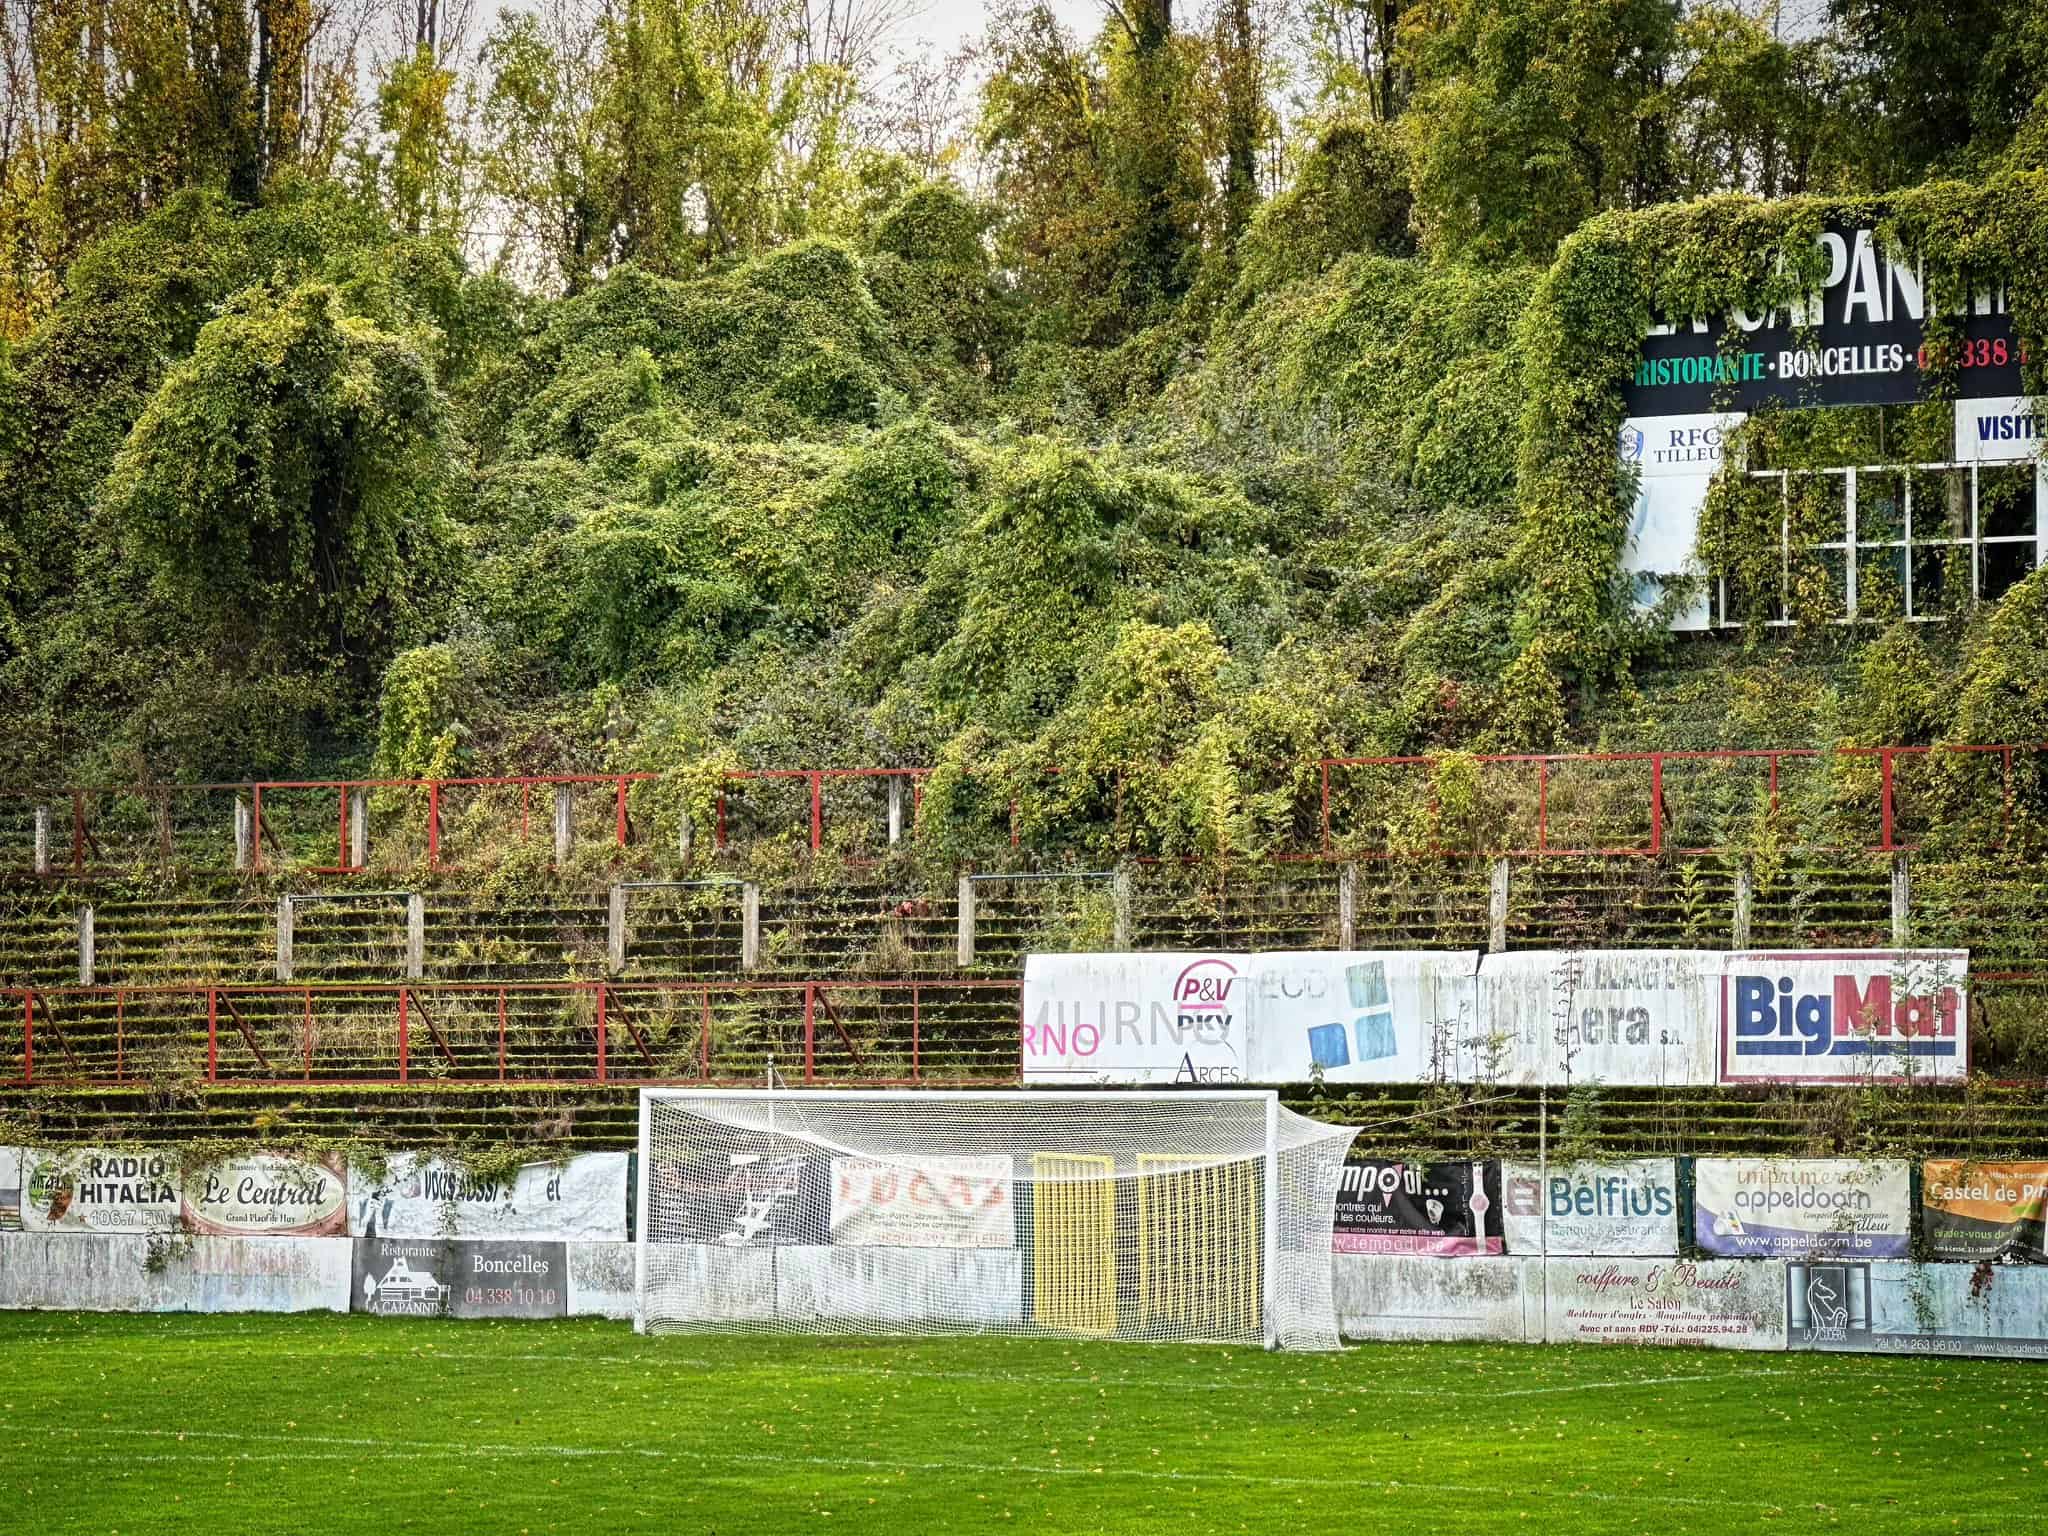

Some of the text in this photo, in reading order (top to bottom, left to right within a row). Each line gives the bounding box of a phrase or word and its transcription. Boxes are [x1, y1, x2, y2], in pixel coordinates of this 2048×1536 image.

[1635, 352, 1766, 386] RISTORANTE
[1779, 343, 1904, 378] BONCELLES
[1961, 338, 2008, 367] 338
[1654, 447, 1721, 463] TILLEU
[1182, 978, 1233, 1000] P&V
[1736, 975, 1960, 1056] BigMat
[90, 1158, 165, 1178] RADIO
[80, 1183, 176, 1204] HITALIA
[200, 1176, 328, 1207] Le Central
[1550, 1176, 1674, 1217] Belfius
[1735, 1185, 1872, 1214] appeldoorn
[1930, 1182, 1989, 1200] Castel
[1994, 1184, 2017, 1201] de
[90, 1209, 136, 1226] 106.7
[381, 1243, 437, 1257] Ristorante
[473, 1255, 549, 1274] Boncelles
[466, 1288, 556, 1305] 04 338 10 10
[1647, 1297, 1681, 1311] Salon
